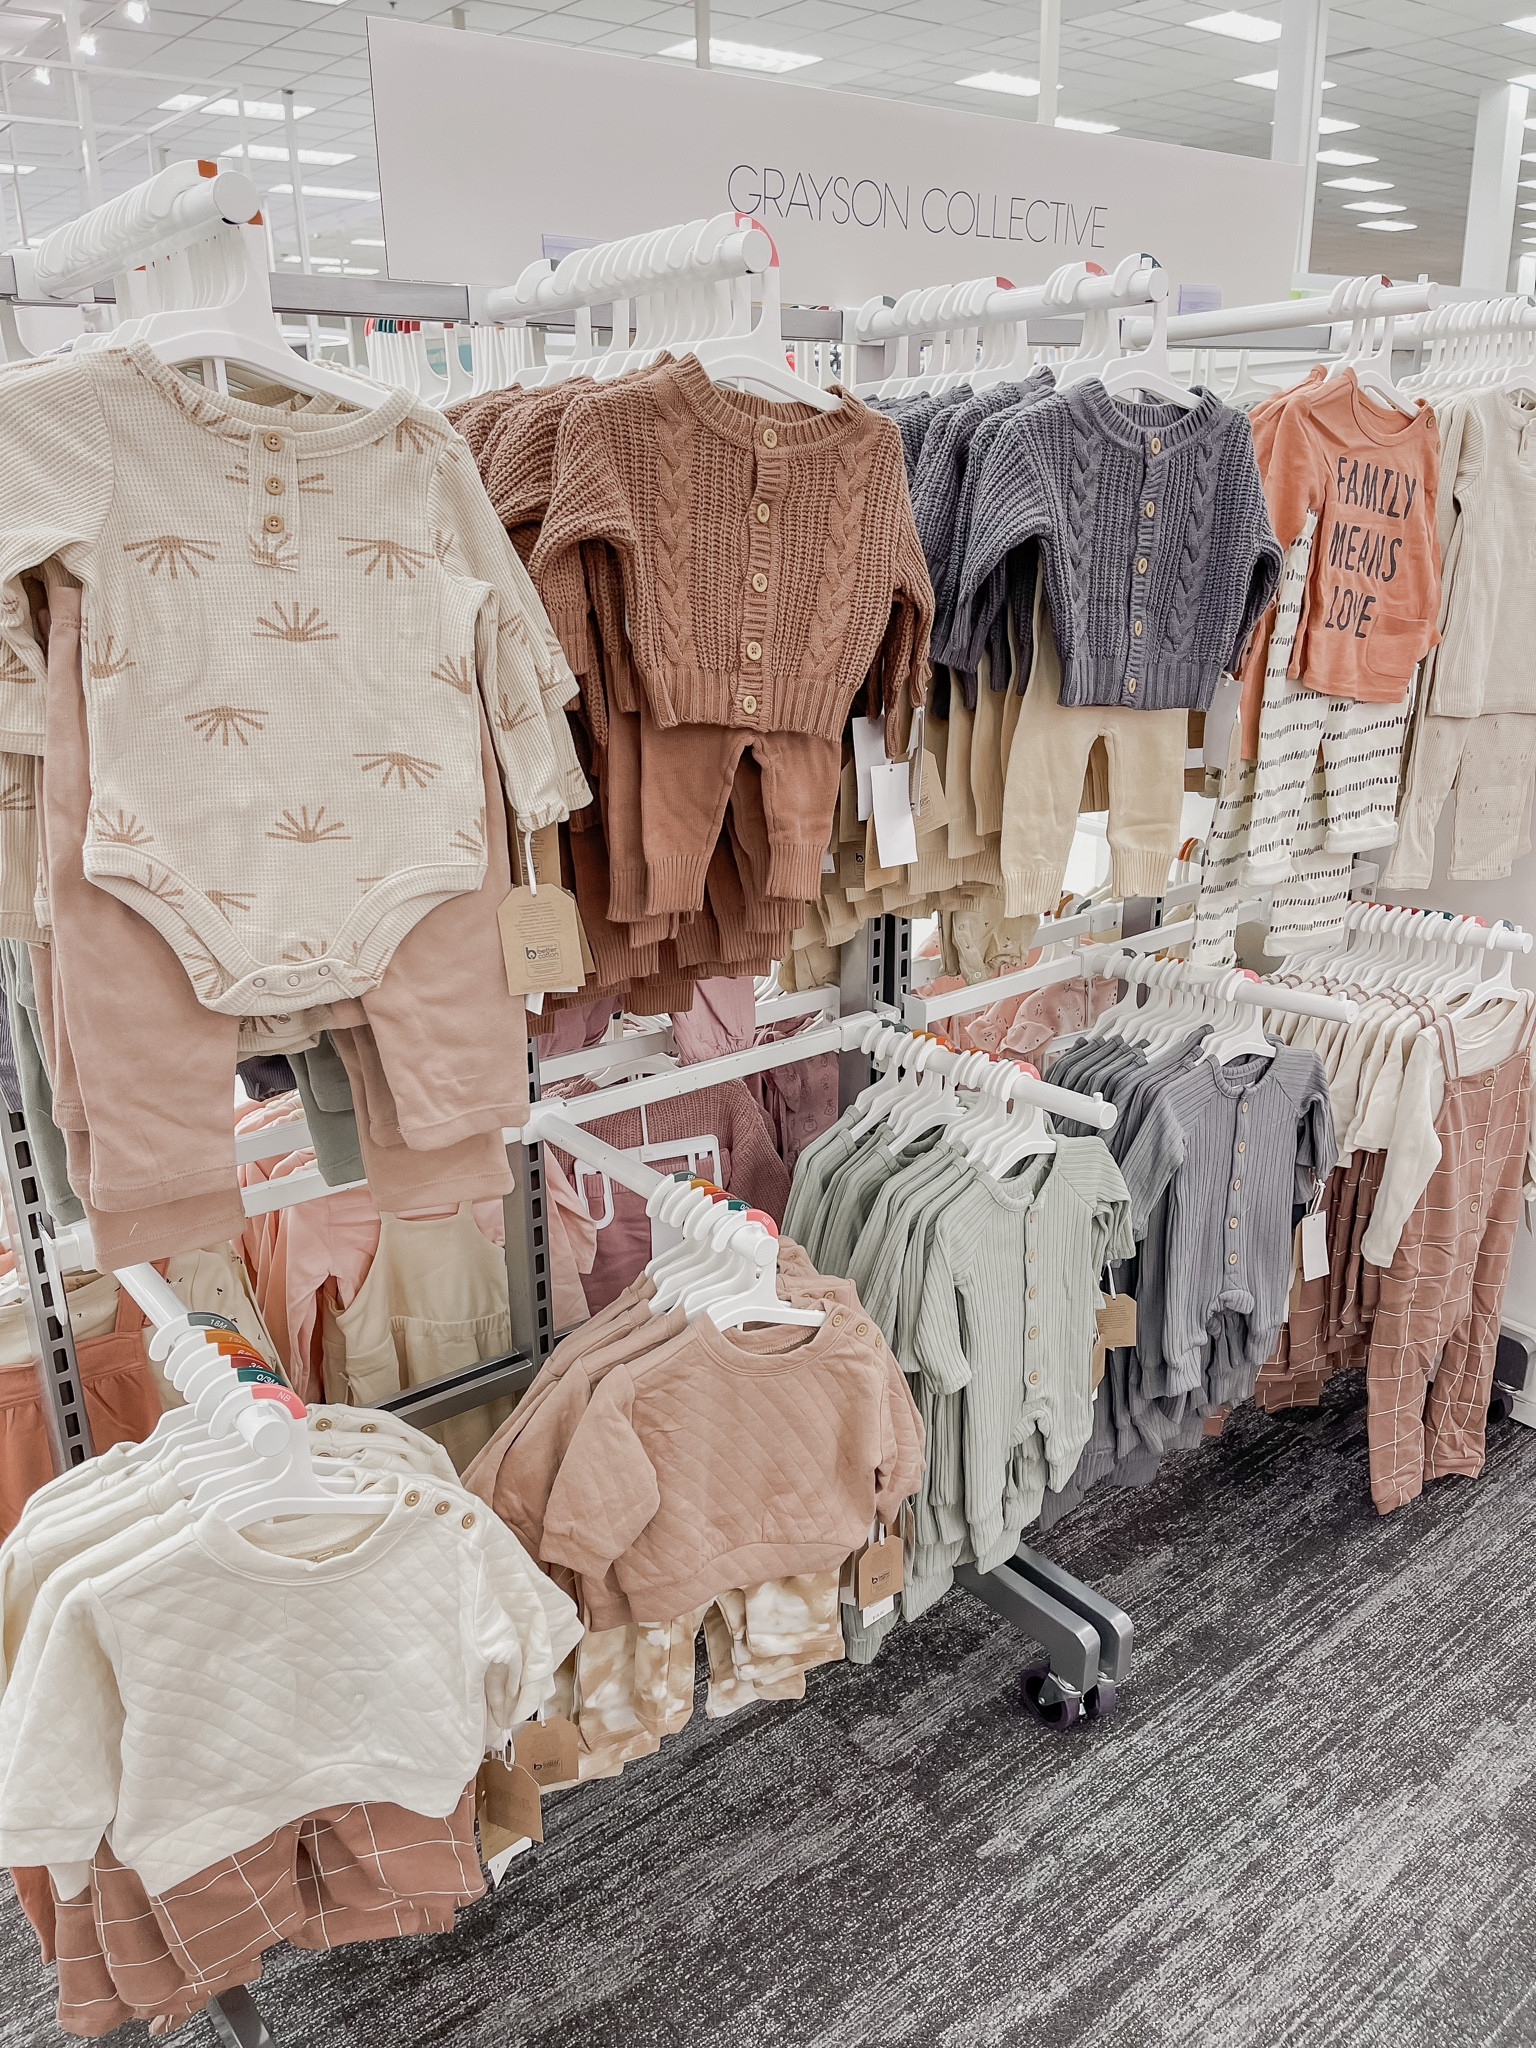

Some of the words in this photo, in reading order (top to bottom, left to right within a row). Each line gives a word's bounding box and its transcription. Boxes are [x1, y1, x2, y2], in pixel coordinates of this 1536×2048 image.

[727, 164, 910, 231] GRAYSON
[921, 187, 1109, 249] COLLECTIVE
[1337, 456, 1417, 520] FAMILY
[1328, 520, 1403, 583] MEANS
[1324, 585, 1377, 639] LOVE
[277, 1391, 291, 1402] NB
